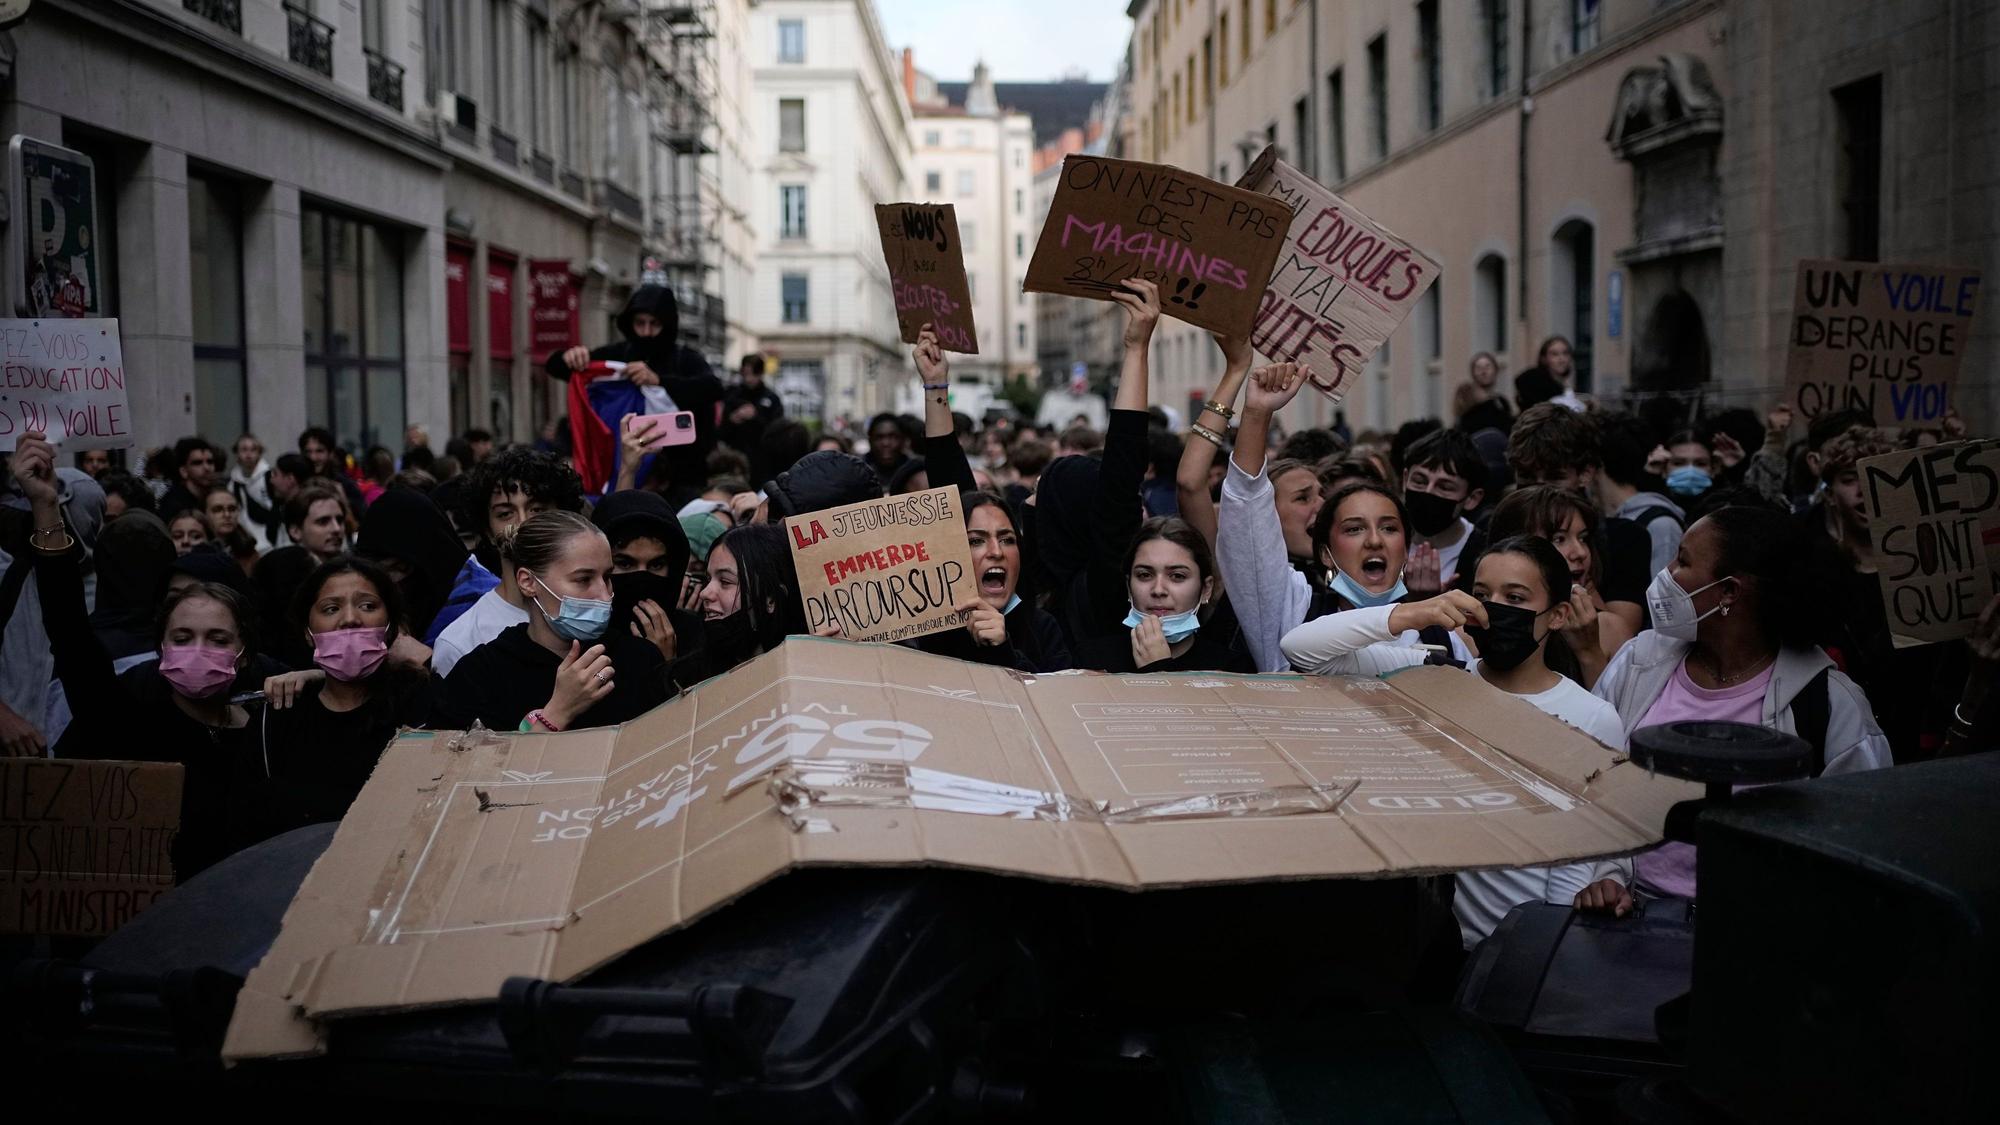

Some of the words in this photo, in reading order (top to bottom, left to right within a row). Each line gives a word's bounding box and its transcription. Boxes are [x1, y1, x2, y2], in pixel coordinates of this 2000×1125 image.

[1068, 160, 1124, 192] ON
[1127, 171, 1225, 215] N'EST
[1227, 200, 1279, 239] PAS
[1137, 204, 1194, 243] DES
[901, 206, 947, 252] NOUS
[1061, 214, 1248, 290] MACHINES
[1296, 207, 1423, 301] ÉDUQUÉS
[1269, 253, 1346, 329] MAL
[1806, 269, 1862, 308] UN
[1883, 272, 1981, 316] VOILE
[933, 318, 971, 348] NOUS
[1797, 315, 1956, 356] DERANGE
[1849, 353, 1923, 382] PLUS
[20, 400, 47, 432] DU
[56, 401, 127, 437] VOILE
[1865, 445, 1999, 517] MES
[792, 520, 829, 549] LA
[832, 492, 953, 538] JEUNESSE
[824, 541, 930, 586] EMMERDE
[1882, 517, 1978, 581] SONT
[807, 560, 963, 637] PARCOURSUP
[1894, 577, 1980, 626] QUE
[891, 624, 916, 640] COMPTE
[917, 621, 931, 633] PLUS
[802, 702, 857, 716] TV
[538, 703, 788, 824] INNOVATION
[724, 714, 933, 794] 55
[0, 762, 73, 822] LEZ
[88, 764, 139, 822] VOS
[601, 764, 718, 828] YEARS
[1368, 792, 1518, 809] QLED
[532, 825, 593, 843] OF
